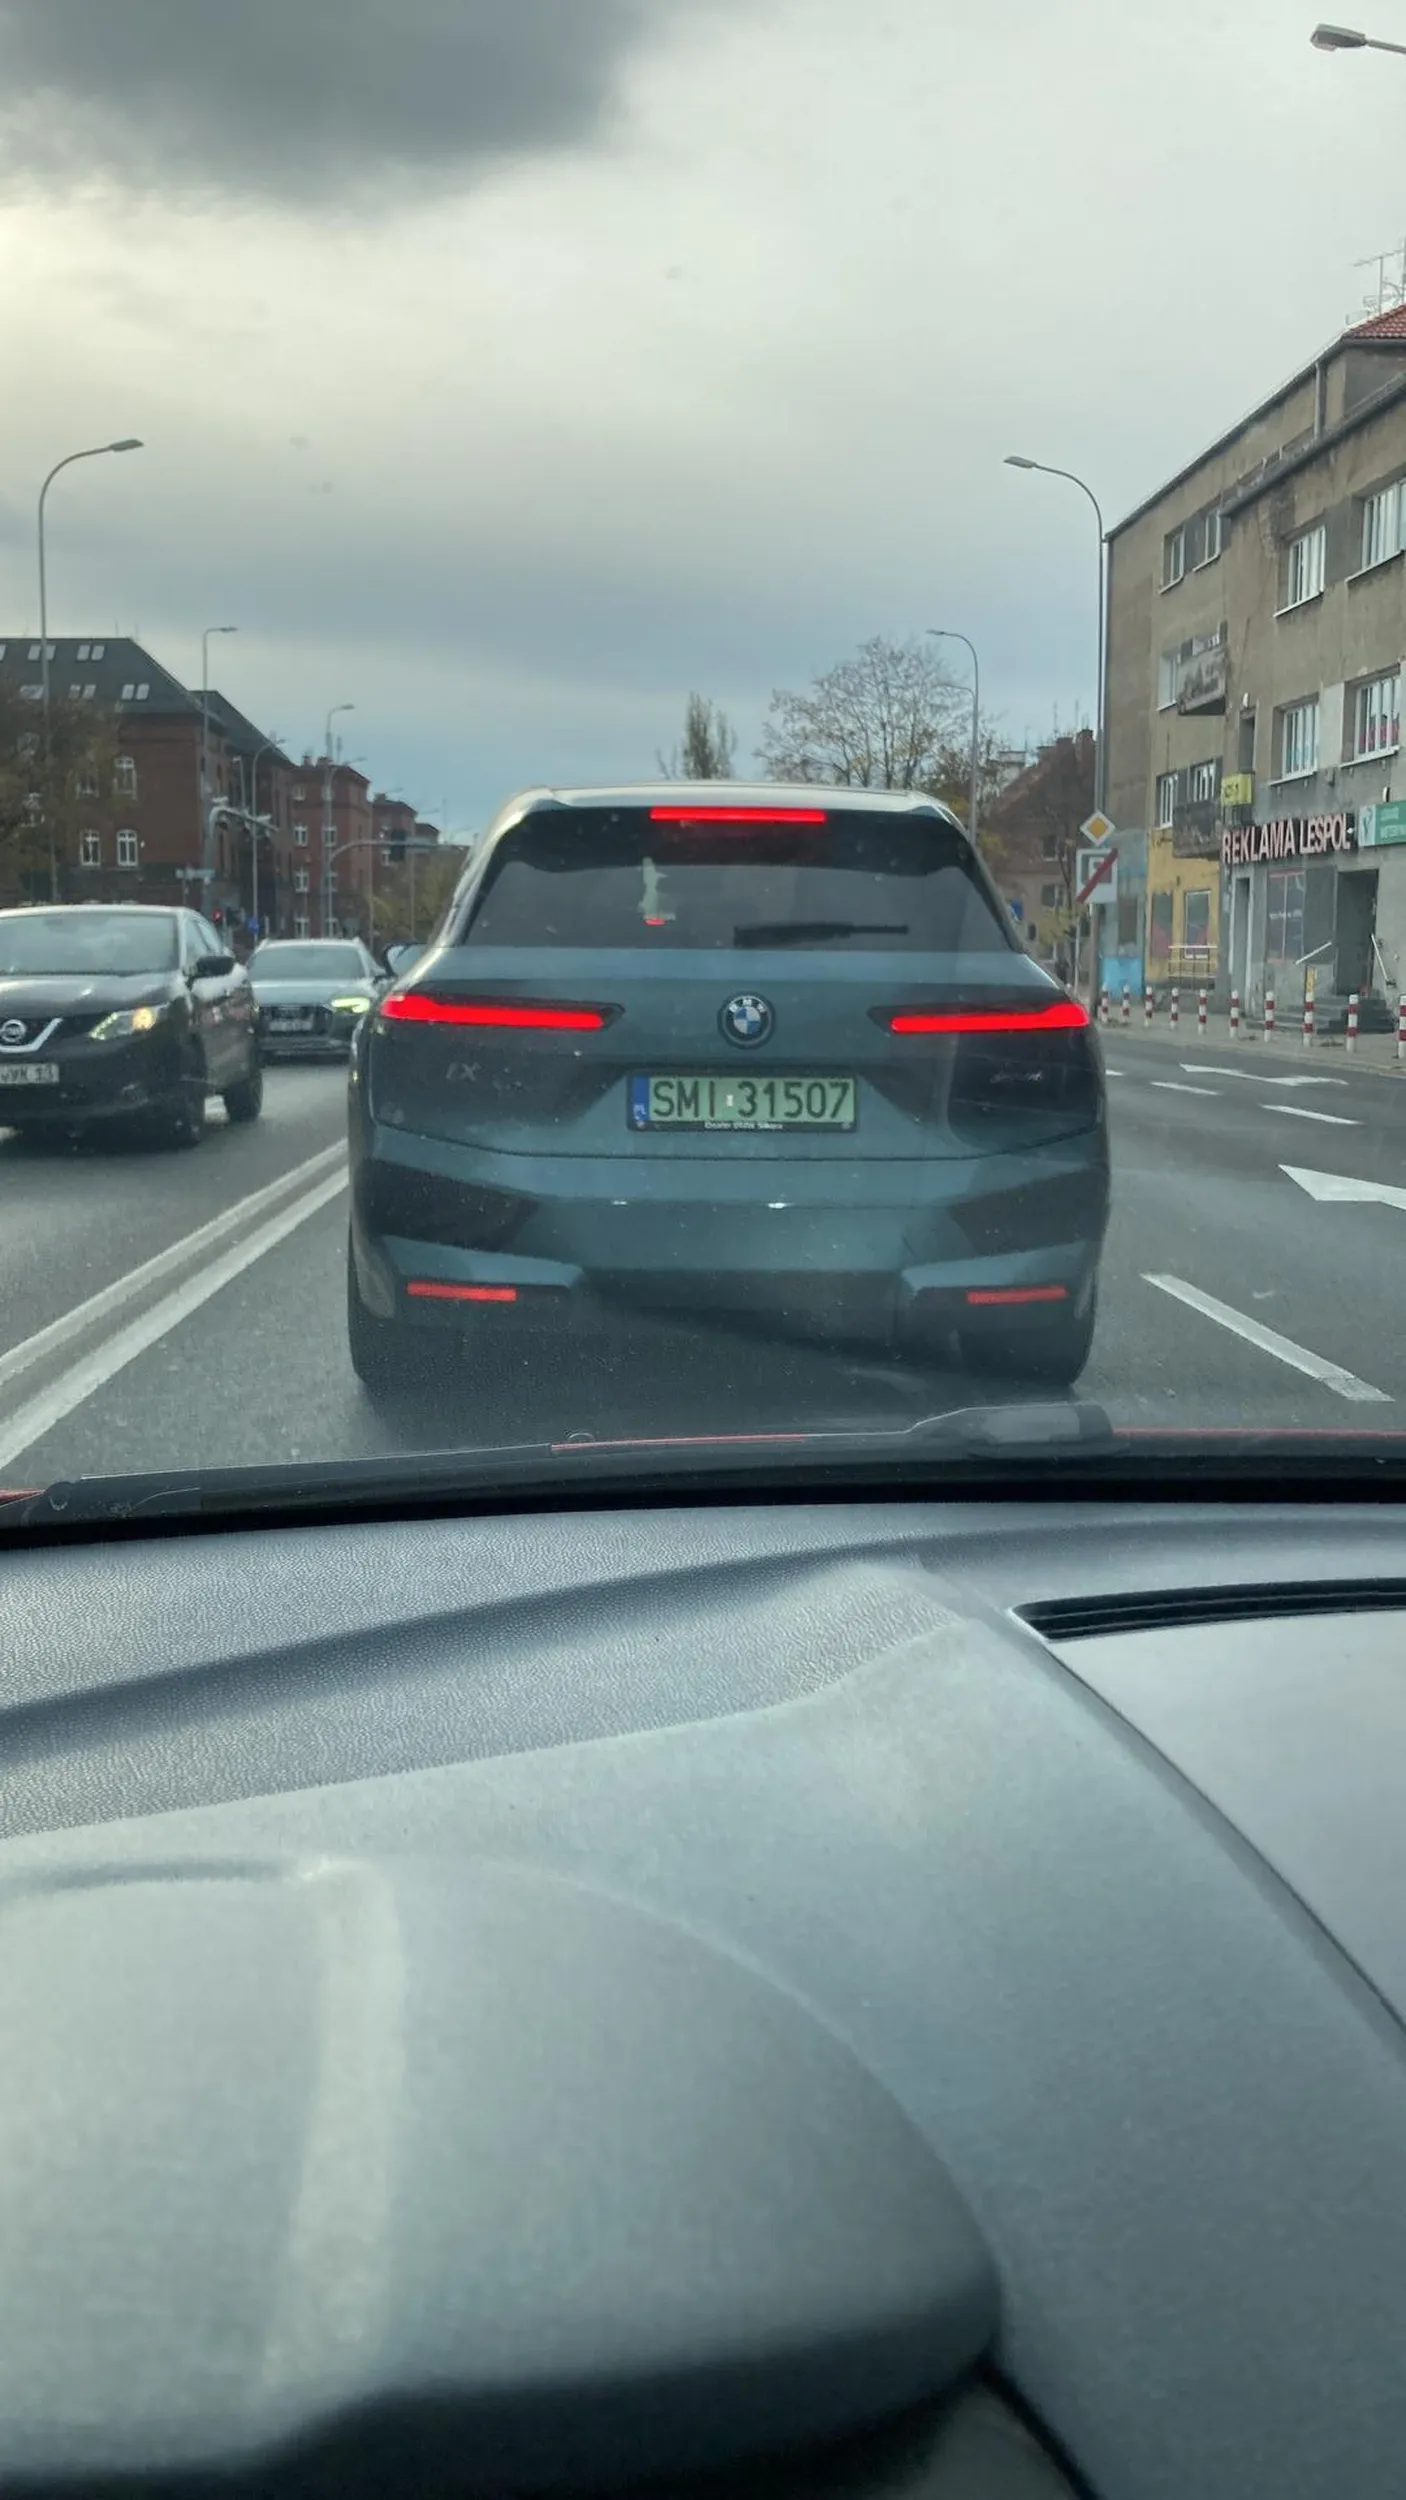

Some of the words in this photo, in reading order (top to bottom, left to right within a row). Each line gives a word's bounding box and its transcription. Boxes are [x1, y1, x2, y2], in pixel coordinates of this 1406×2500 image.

[1222, 816, 1296, 864] REKLAMA
[1300, 812, 1351, 855] LESPOL
[728, 998, 766, 1012] BMW
[653, 1080, 715, 1118] SMI
[737, 1081, 850, 1119] 31507
